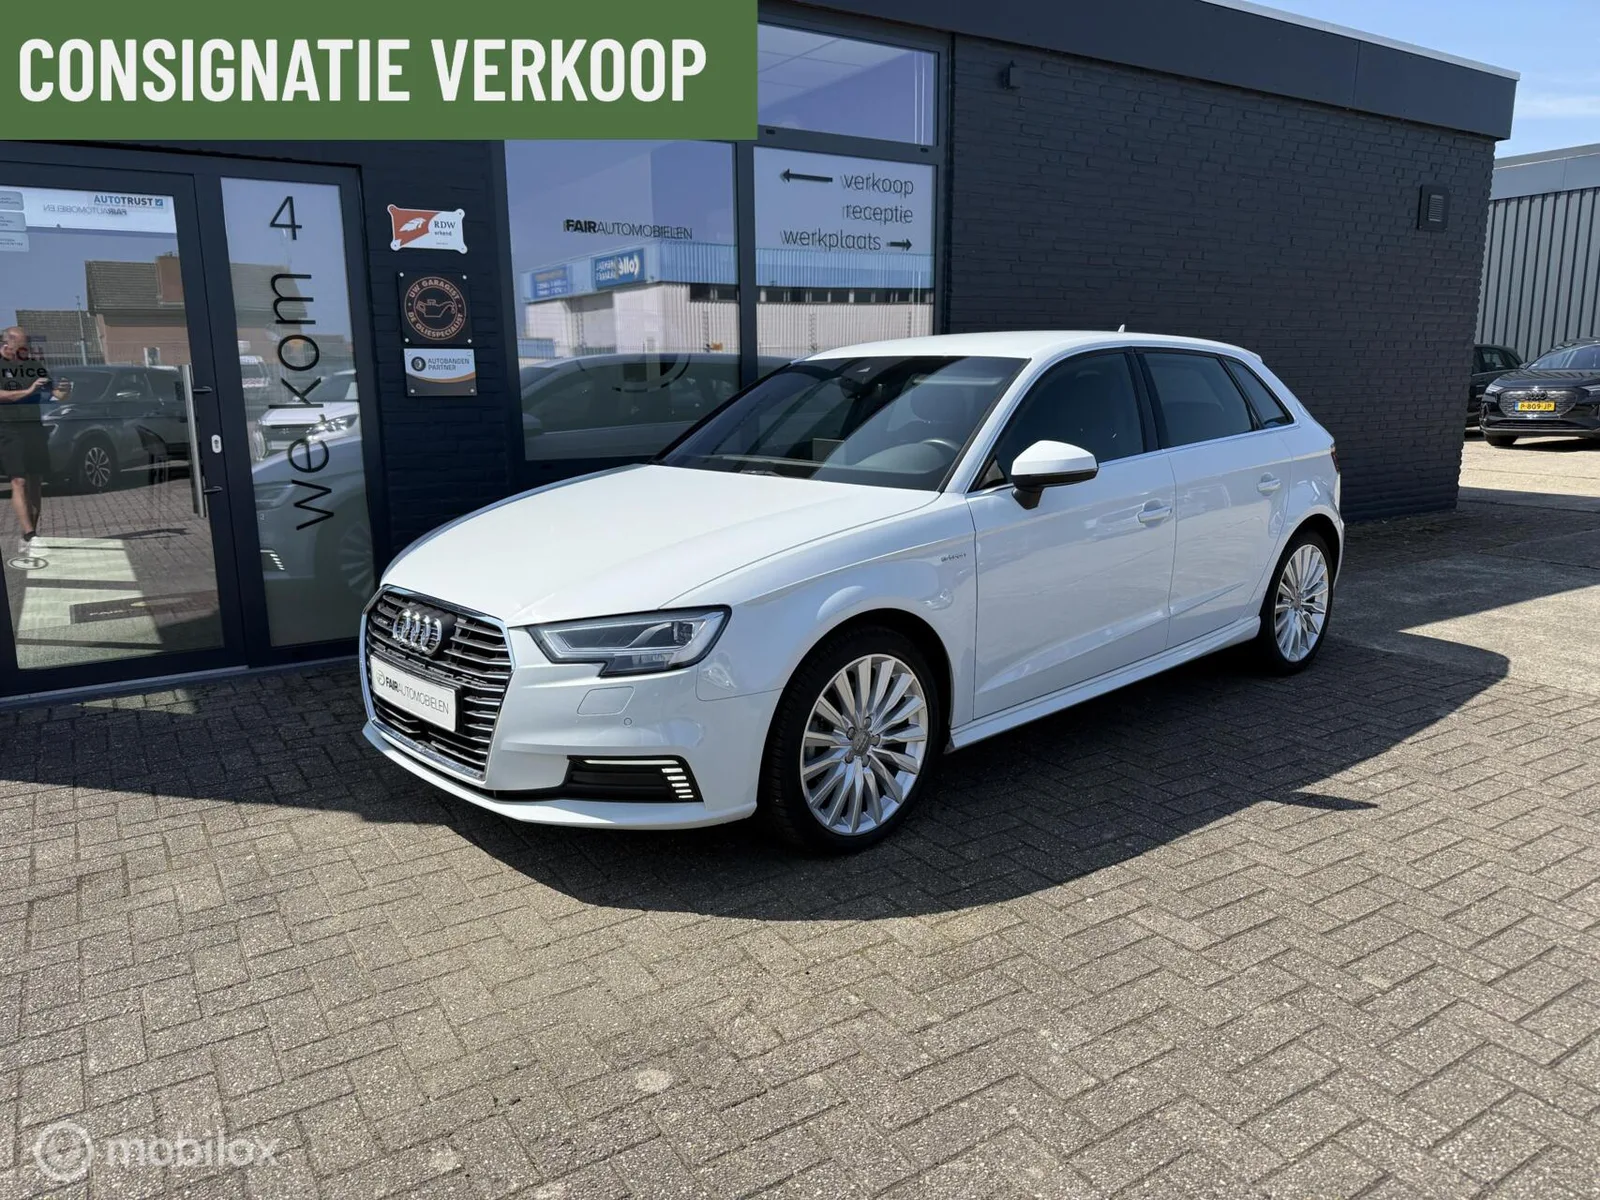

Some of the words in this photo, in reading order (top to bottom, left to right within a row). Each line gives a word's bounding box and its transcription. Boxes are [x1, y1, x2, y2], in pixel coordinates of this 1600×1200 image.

[841, 172, 914, 199] verkoop
[94, 194, 153, 206] AUTOTRUST
[434, 220, 456, 229] RDW
[843, 204, 914, 225] receptie
[781, 227, 882, 252] werkplaats
[409, 284, 421, 298] UW
[421, 279, 460, 299] GARAGIST
[408, 311, 417, 323] DE
[415, 313, 463, 337] OLIESPECIALIST
[427, 357, 470, 365] AUTOBANDEN
